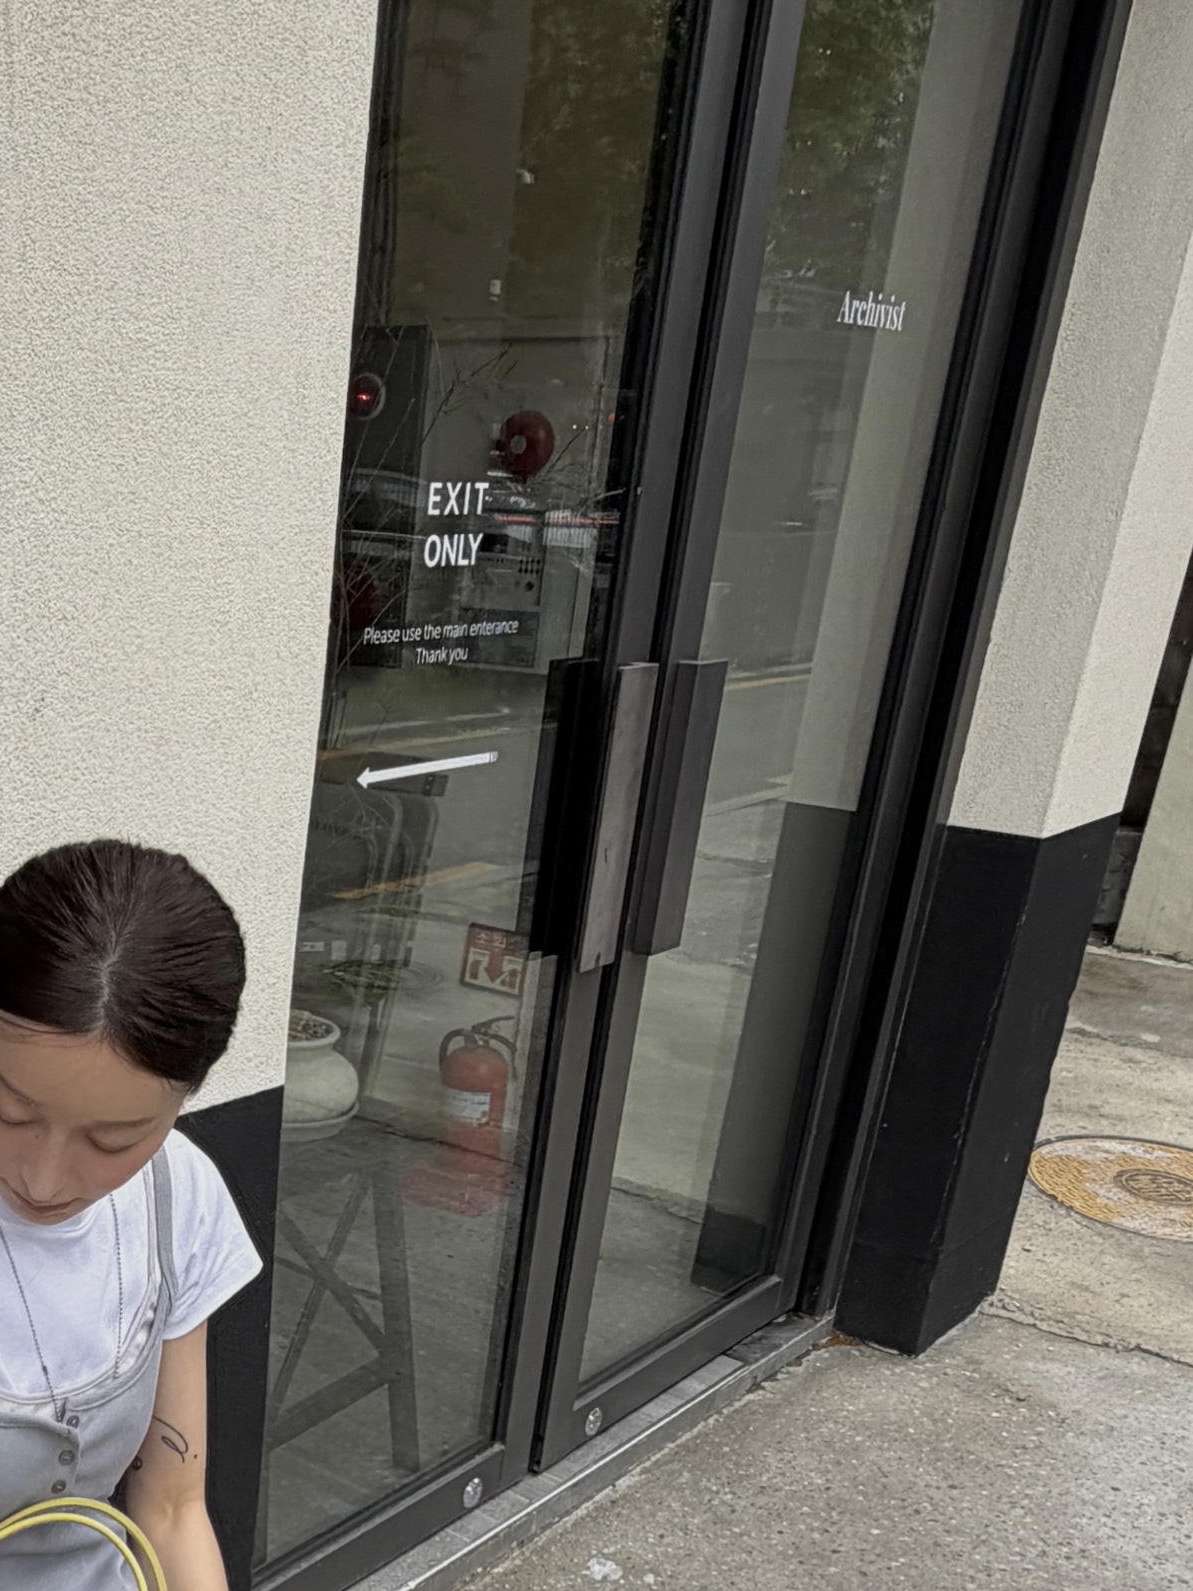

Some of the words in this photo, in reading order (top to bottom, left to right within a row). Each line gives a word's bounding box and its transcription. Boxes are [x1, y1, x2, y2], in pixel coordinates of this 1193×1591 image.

[836, 290, 906, 332] Archivist
[427, 482, 490, 516] EXIT
[424, 533, 484, 568] ONLY
[363, 626, 401, 645] Please
[402, 627, 422, 642] use
[423, 624, 441, 640] the
[443, 622, 468, 639] main
[416, 646, 447, 665] Thank
[447, 647, 469, 666] you
